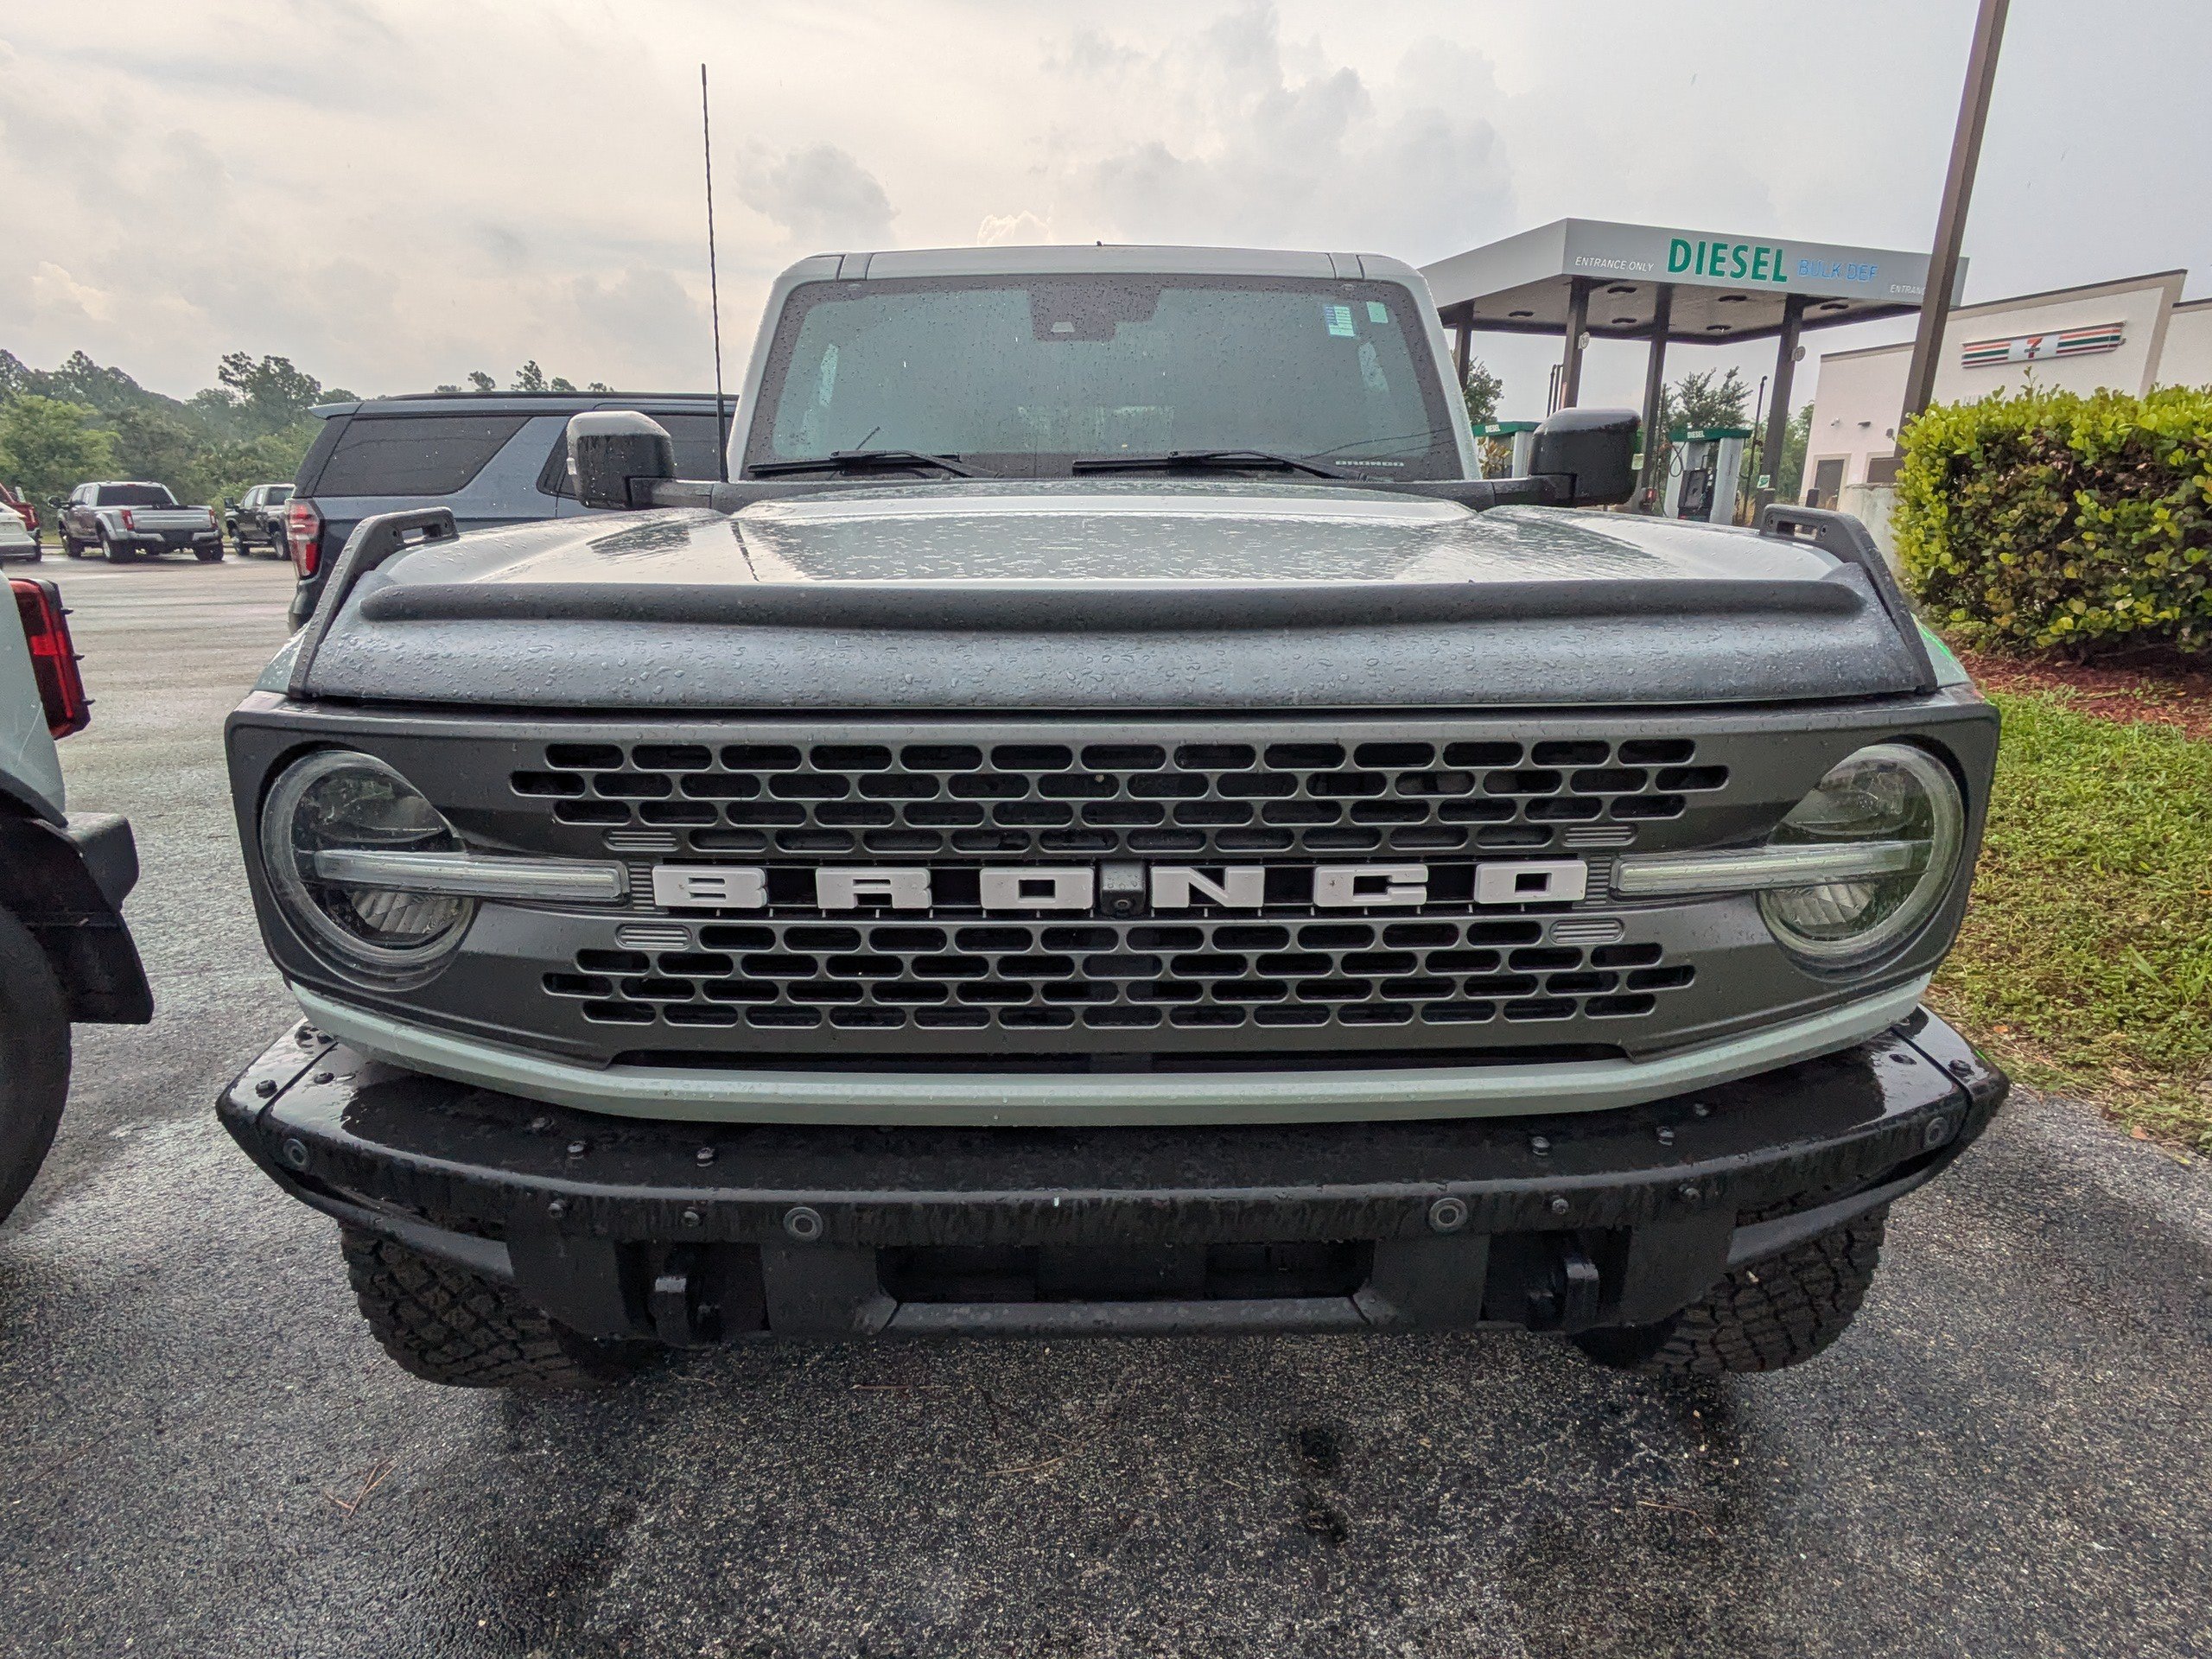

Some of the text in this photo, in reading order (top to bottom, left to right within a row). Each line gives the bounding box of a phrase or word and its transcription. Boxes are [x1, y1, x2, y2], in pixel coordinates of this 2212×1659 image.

[1574, 256, 1655, 272] ENTRANCE ONLY
[1668, 238, 1788, 283] DIESEL
[1797, 259, 1878, 283] BULK DEF
[2026, 336, 2044, 359] 7
[652, 860, 1588, 910] BRONCO
